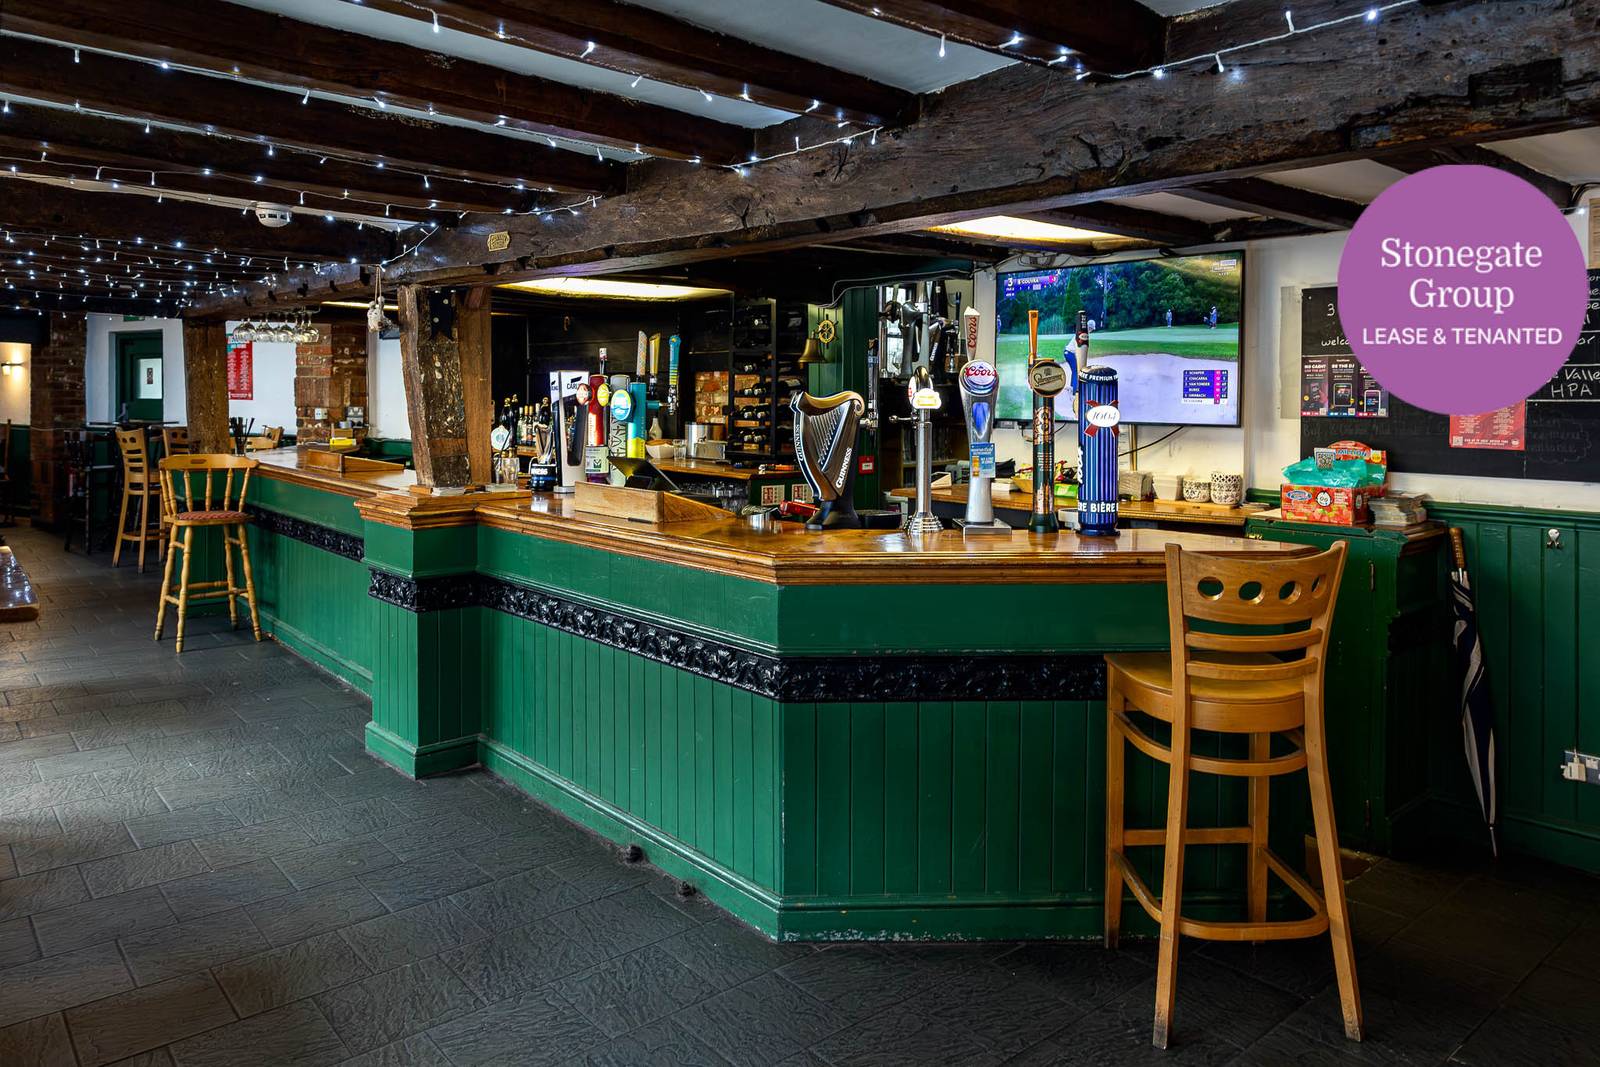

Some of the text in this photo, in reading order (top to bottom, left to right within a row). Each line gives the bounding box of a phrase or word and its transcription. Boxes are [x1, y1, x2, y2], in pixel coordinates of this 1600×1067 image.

[967, 317, 977, 349] Coors
[965, 366, 997, 377] Coors
[1089, 374, 1113, 382] PREMIUM
[1551, 383, 1593, 398] HPA
[836, 447, 853, 488] GUINNESS
[1091, 501, 1115, 513] BIÈRE
